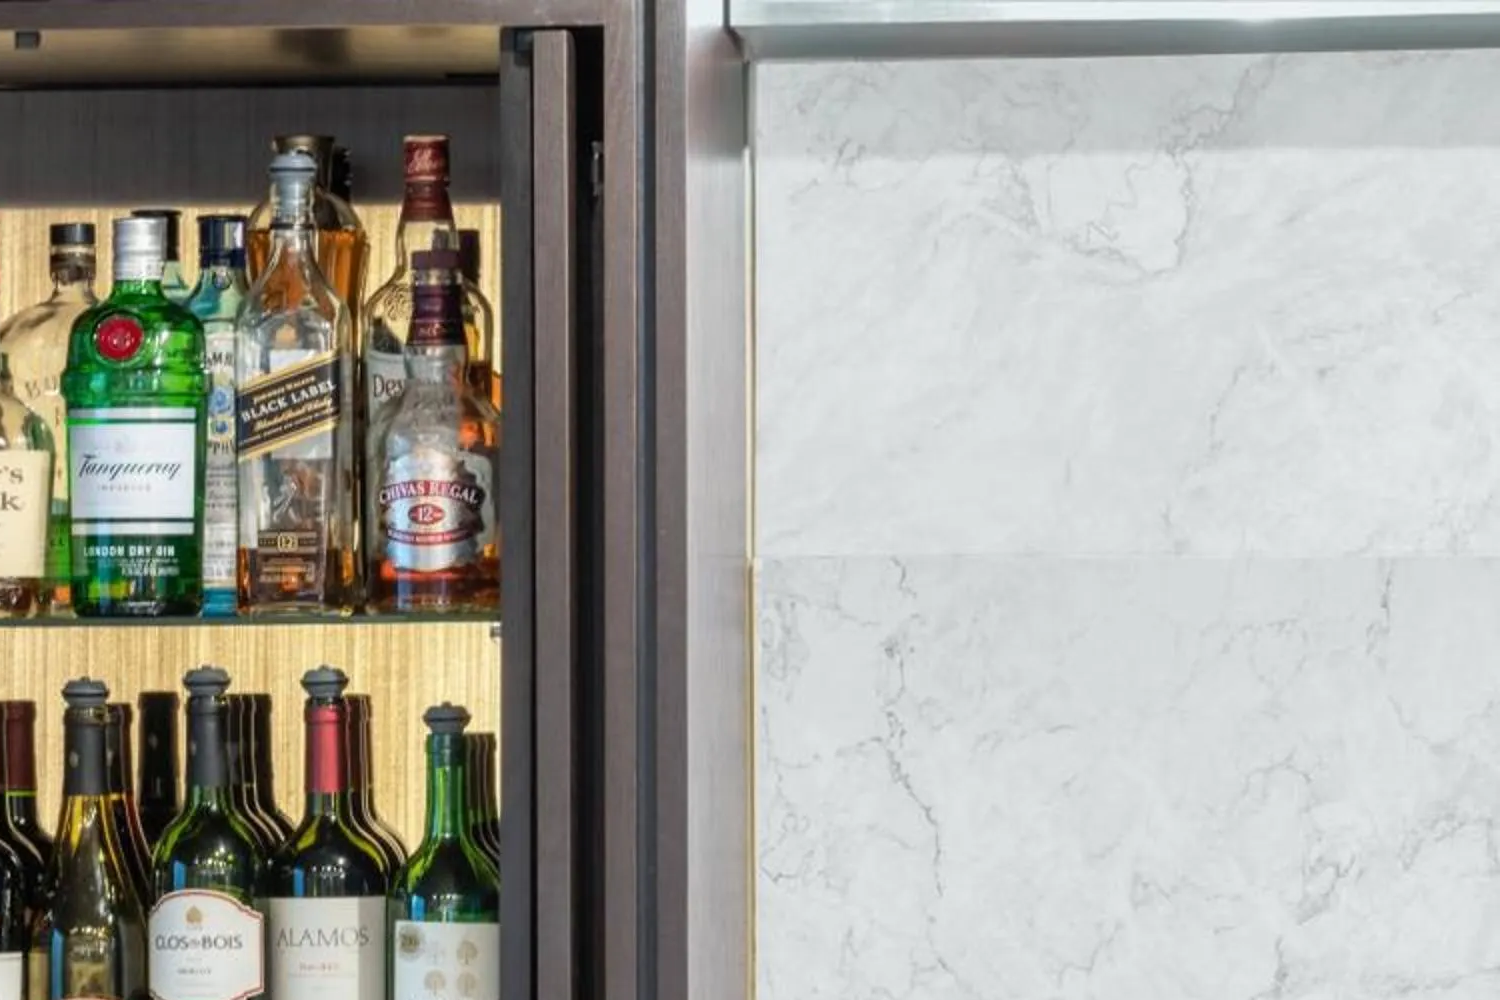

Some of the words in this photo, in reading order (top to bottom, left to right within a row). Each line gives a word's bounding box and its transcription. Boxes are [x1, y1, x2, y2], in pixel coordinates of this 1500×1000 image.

[240, 396, 288, 423] BLACK
[290, 379, 337, 404] LABEL
[78, 453, 182, 481] Tanqueray
[379, 481, 427, 505] CHIVAS
[430, 481, 479, 505] REGAL
[83, 544, 125, 557] LONDON
[129, 544, 151, 557] DRY
[155, 934, 189, 950] CLOS
[201, 934, 244, 950] BOIS
[277, 926, 371, 948] ALAMOS
